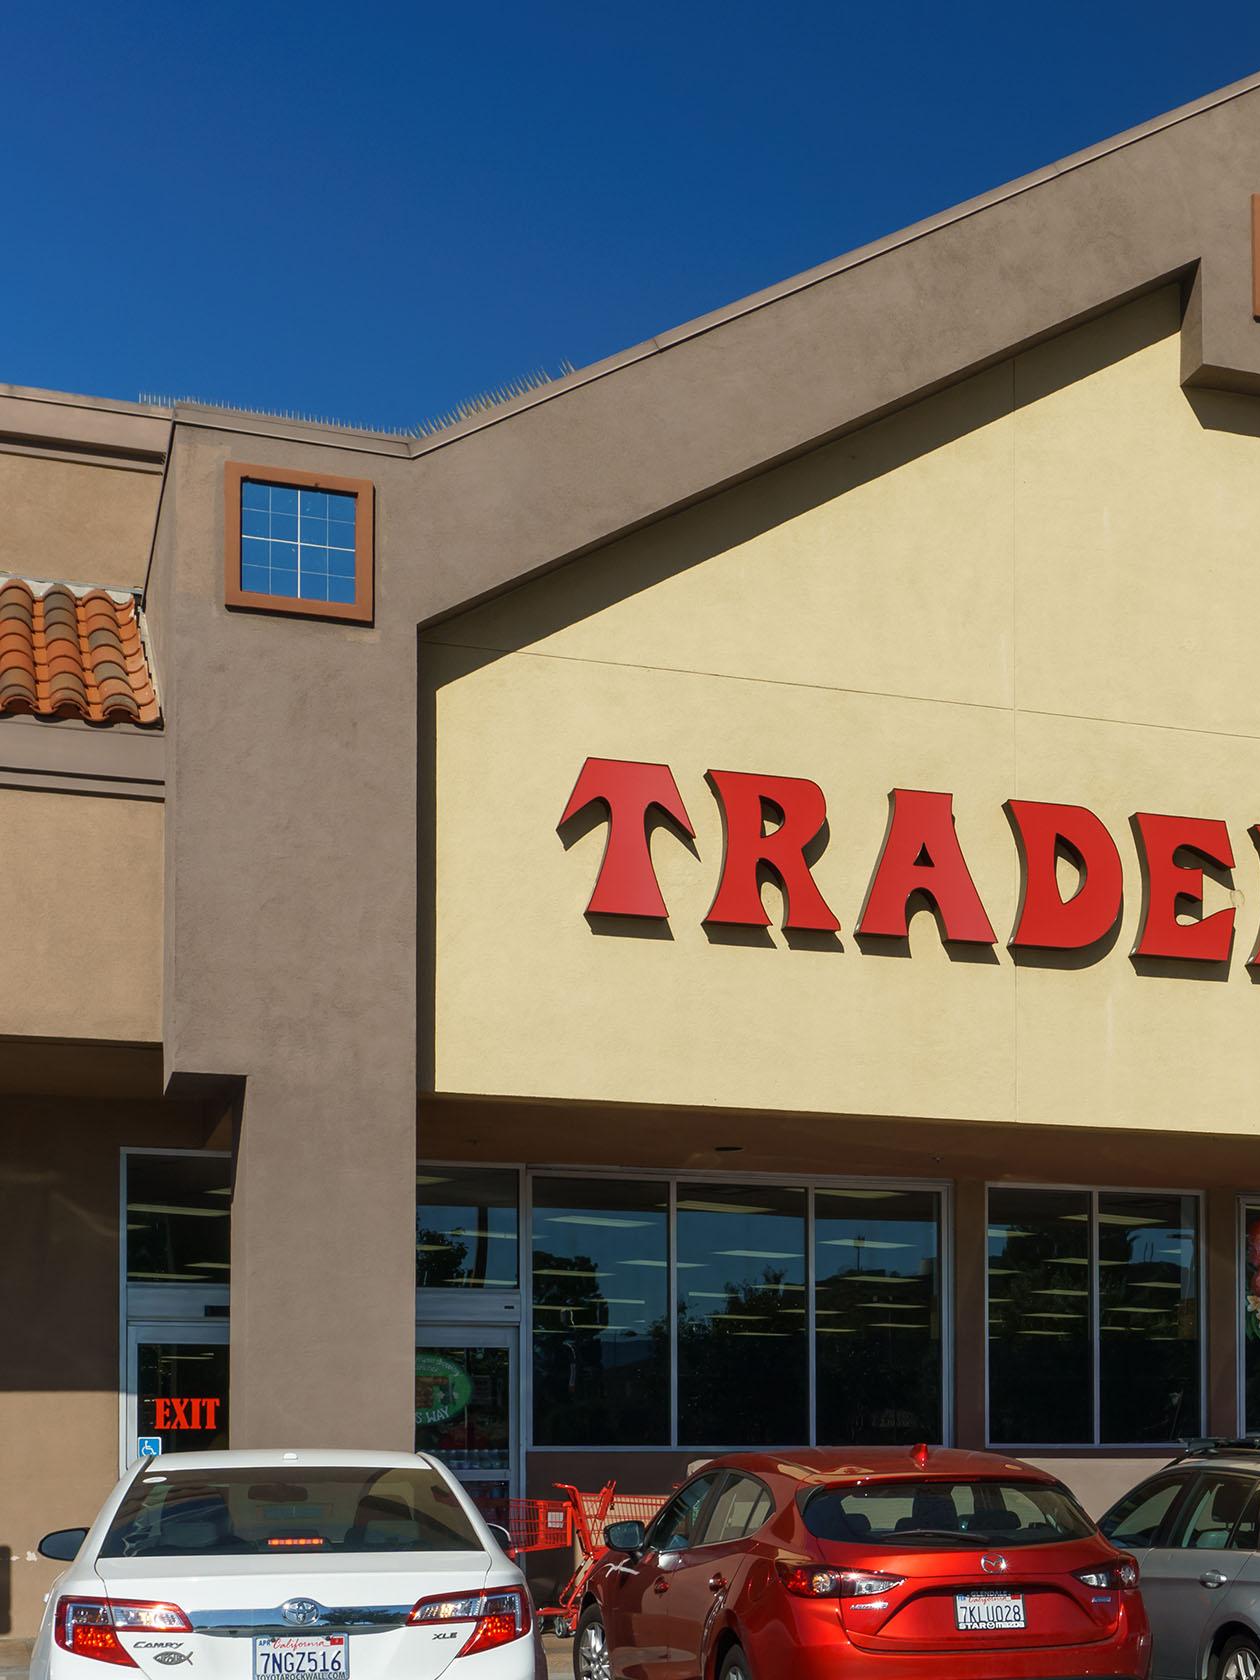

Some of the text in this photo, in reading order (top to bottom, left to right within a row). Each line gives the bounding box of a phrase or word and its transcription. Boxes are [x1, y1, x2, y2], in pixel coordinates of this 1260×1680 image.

[154, 1398, 220, 1430] EXIT
[425, 1405, 450, 1424] WAY
[959, 1604, 1021, 1623] 7KLU028
[958, 1622, 987, 1630] STAR
[432, 1631, 458, 1641] XLE
[133, 1641, 185, 1649] CAMRY
[258, 1639, 271, 1647] APR
[272, 1637, 330, 1651] California
[259, 1650, 342, 1674] 7NGZ516
[256, 1671, 346, 1680] TOYOTAROCKWALL.COM
